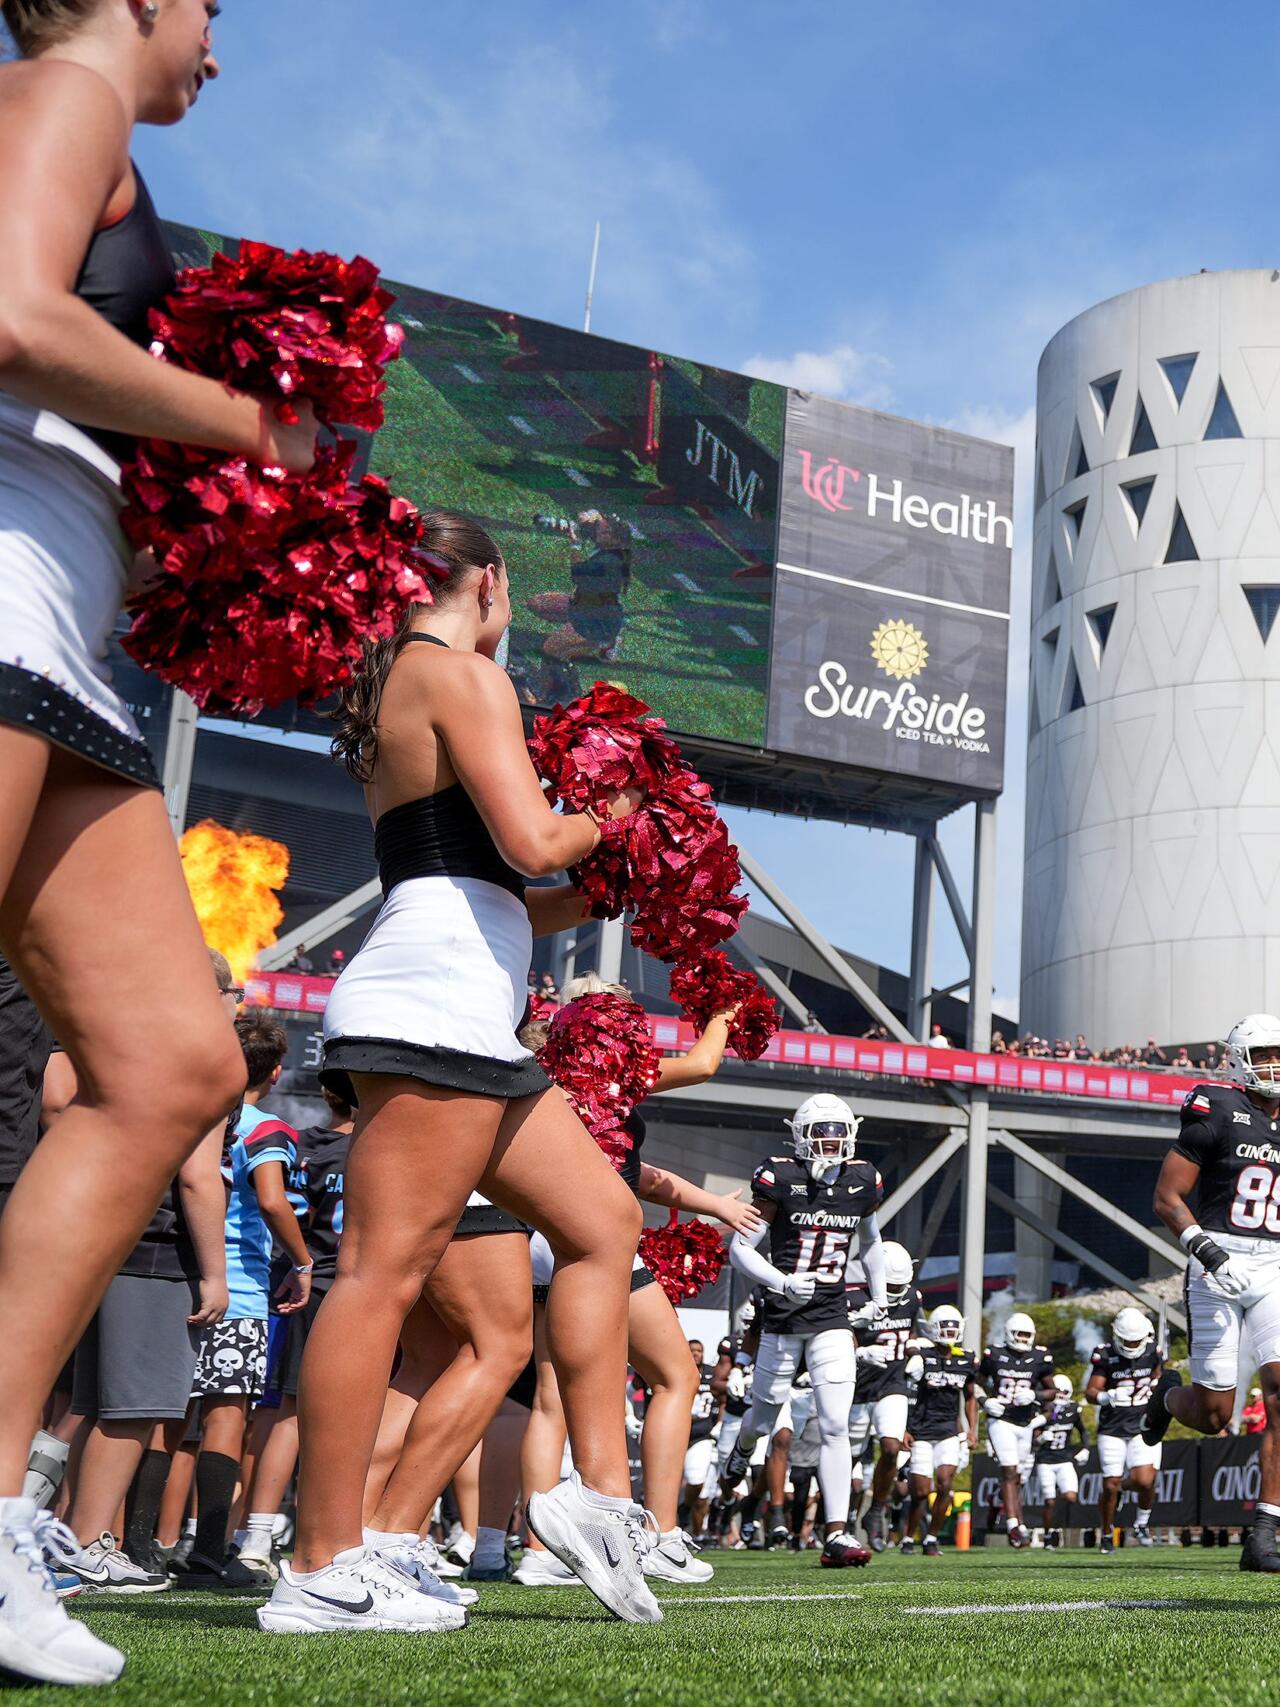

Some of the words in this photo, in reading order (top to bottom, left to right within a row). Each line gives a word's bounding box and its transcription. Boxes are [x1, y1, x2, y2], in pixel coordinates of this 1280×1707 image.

[686, 419, 763, 519] JTM
[868, 473, 1015, 549] Health
[804, 661, 986, 740] Surfside
[896, 726, 921, 741] ICED
[923, 731, 945, 745] TEA
[954, 739, 990, 754] VODKA
[795, 1230, 848, 1283] 15
[1078, 1469, 1184, 1505] CINATI
